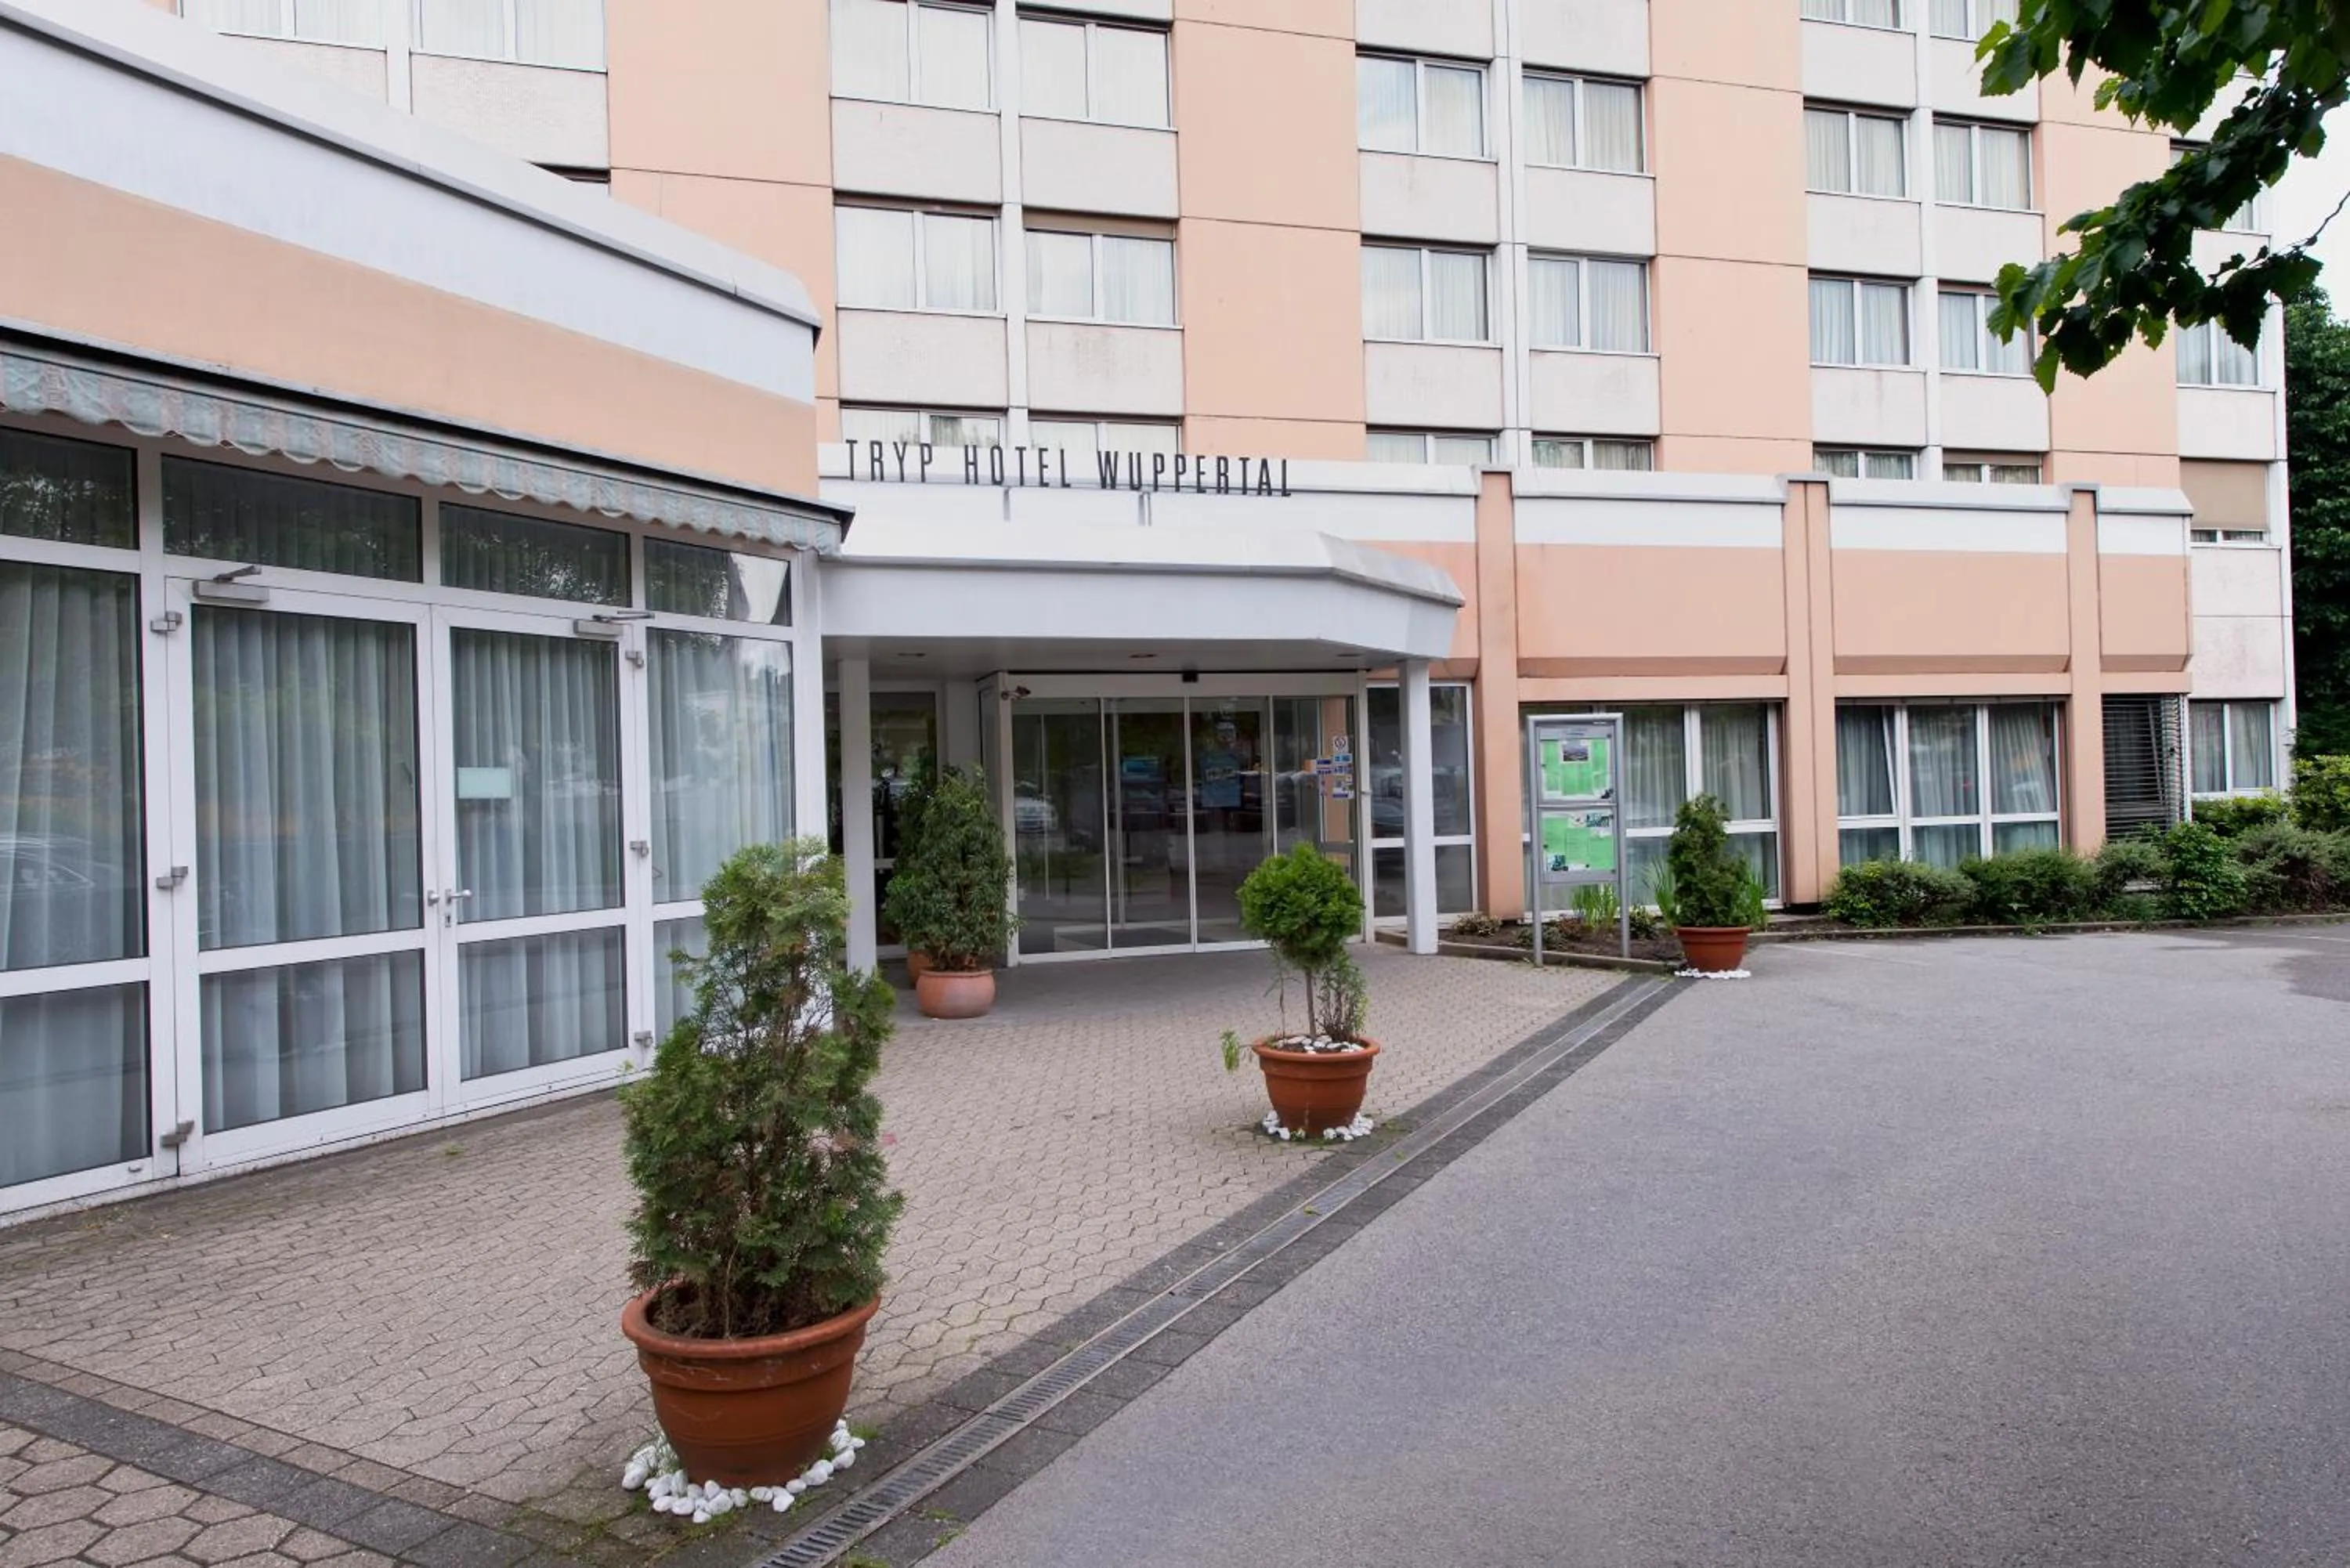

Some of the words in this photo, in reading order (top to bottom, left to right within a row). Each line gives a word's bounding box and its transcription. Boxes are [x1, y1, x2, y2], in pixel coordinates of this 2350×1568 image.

[845, 439, 933, 482] TRYP
[964, 444, 1071, 488] HOTEL
[1097, 450, 1291, 497] WUPPERTAL
